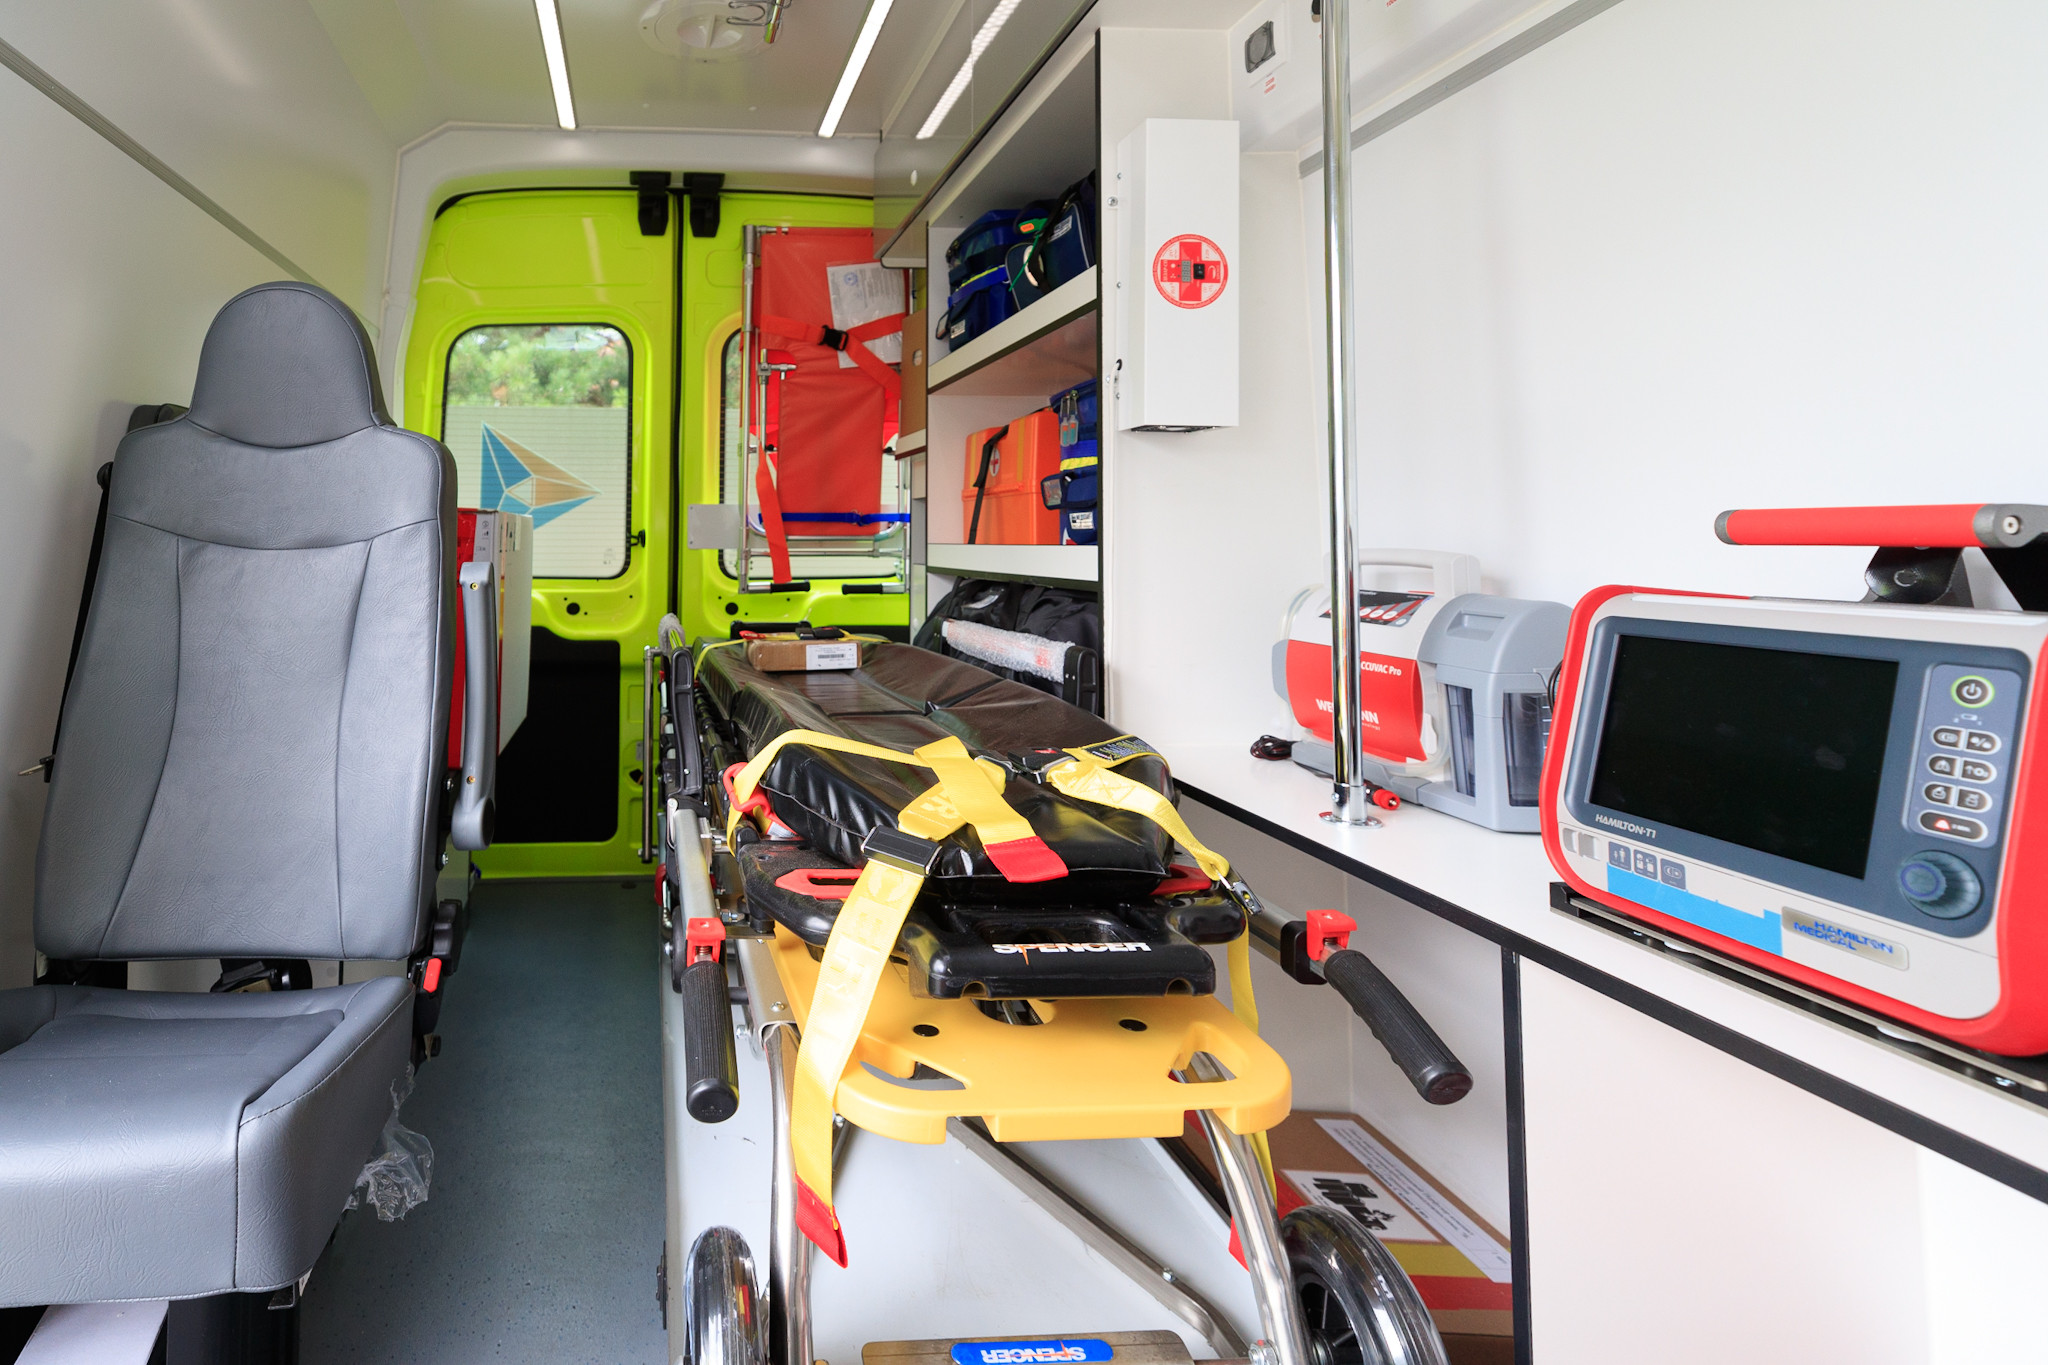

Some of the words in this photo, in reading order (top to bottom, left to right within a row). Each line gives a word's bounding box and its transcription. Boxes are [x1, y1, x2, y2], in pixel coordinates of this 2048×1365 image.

[1361, 661, 1388, 674] CCUVAC
[1388, 666, 1402, 676] Pro
[1793, 922, 1857, 951] MEDICAL
[1814, 921, 1894, 954] HAMILTON
[992, 942, 1152, 955] SPENCER
[980, 1346, 1087, 1363] SPENCER
